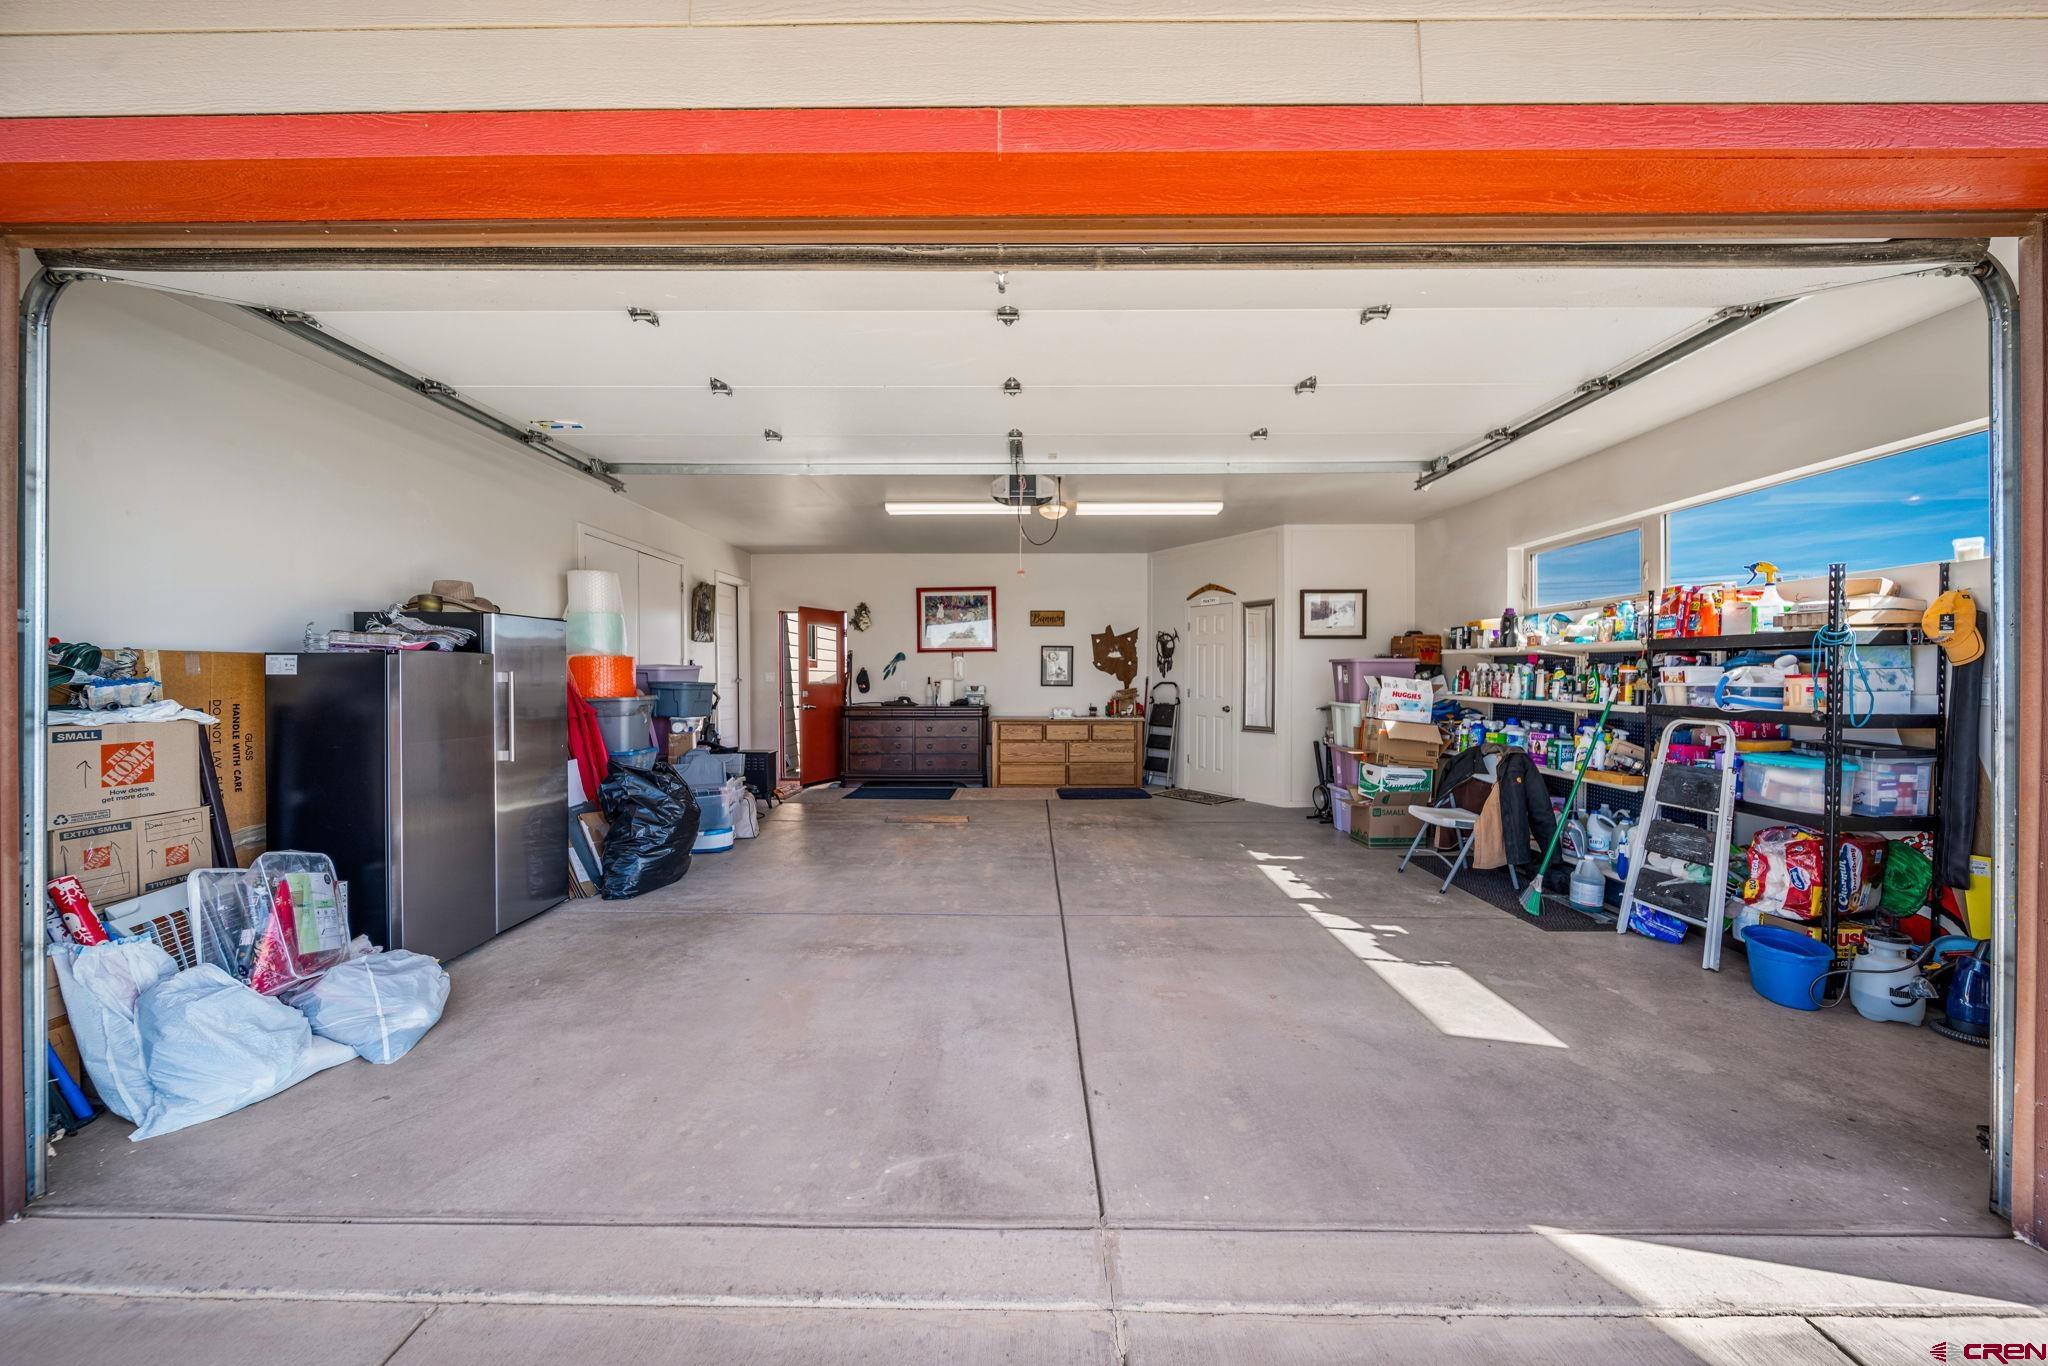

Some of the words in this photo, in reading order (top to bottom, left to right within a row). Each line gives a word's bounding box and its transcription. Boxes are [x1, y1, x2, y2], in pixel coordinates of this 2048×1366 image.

[1031, 612, 1064, 625] Bannon
[1391, 690, 1422, 700] HUGGIES
[212, 699, 222, 716] DO
[232, 703, 241, 740] HANDLE
[56, 731, 98, 742] SMALL
[212, 722, 222, 745] NOT
[232, 742, 241, 767] WITH
[244, 732, 254, 761] GLASS
[102, 740, 154, 787] HOME
[106, 747, 131, 766] THE
[212, 750, 222, 769] LAY
[122, 755, 154, 785] DEPOT
[233, 769, 243, 793] CARE
[101, 796, 115, 804] get
[1381, 808, 1406, 816] SMALL
[63, 828, 97, 840] EXTRA
[98, 823, 129, 834] SMALL
[149, 878, 177, 890] SMALL
[1838, 859, 1849, 907] Charmin
[1889, 987, 1911, 999] Round
